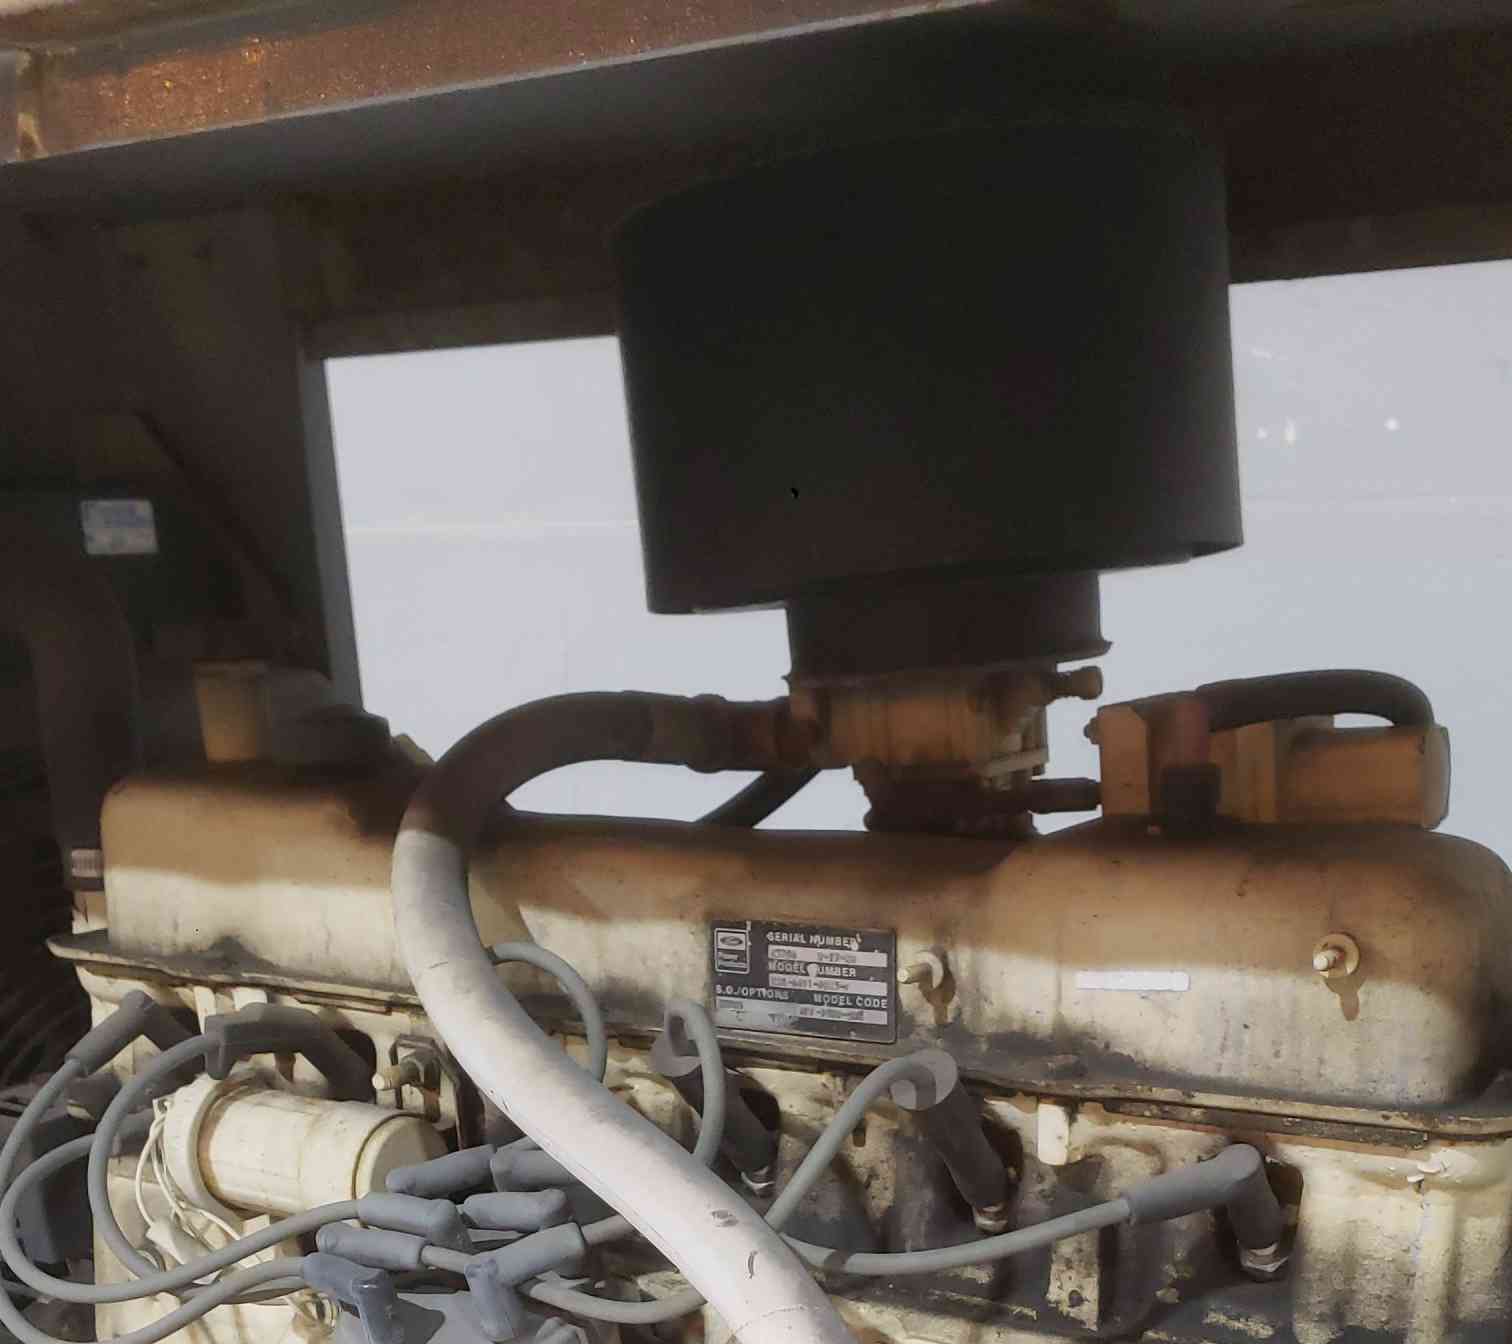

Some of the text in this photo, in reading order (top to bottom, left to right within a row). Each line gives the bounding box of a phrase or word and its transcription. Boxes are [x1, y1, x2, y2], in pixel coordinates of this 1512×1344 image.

[766, 931, 857, 948] SERIAL NUMBER
[768, 960, 857, 977] MODEL UMBER
[813, 993, 888, 1009] MODEL CODE
